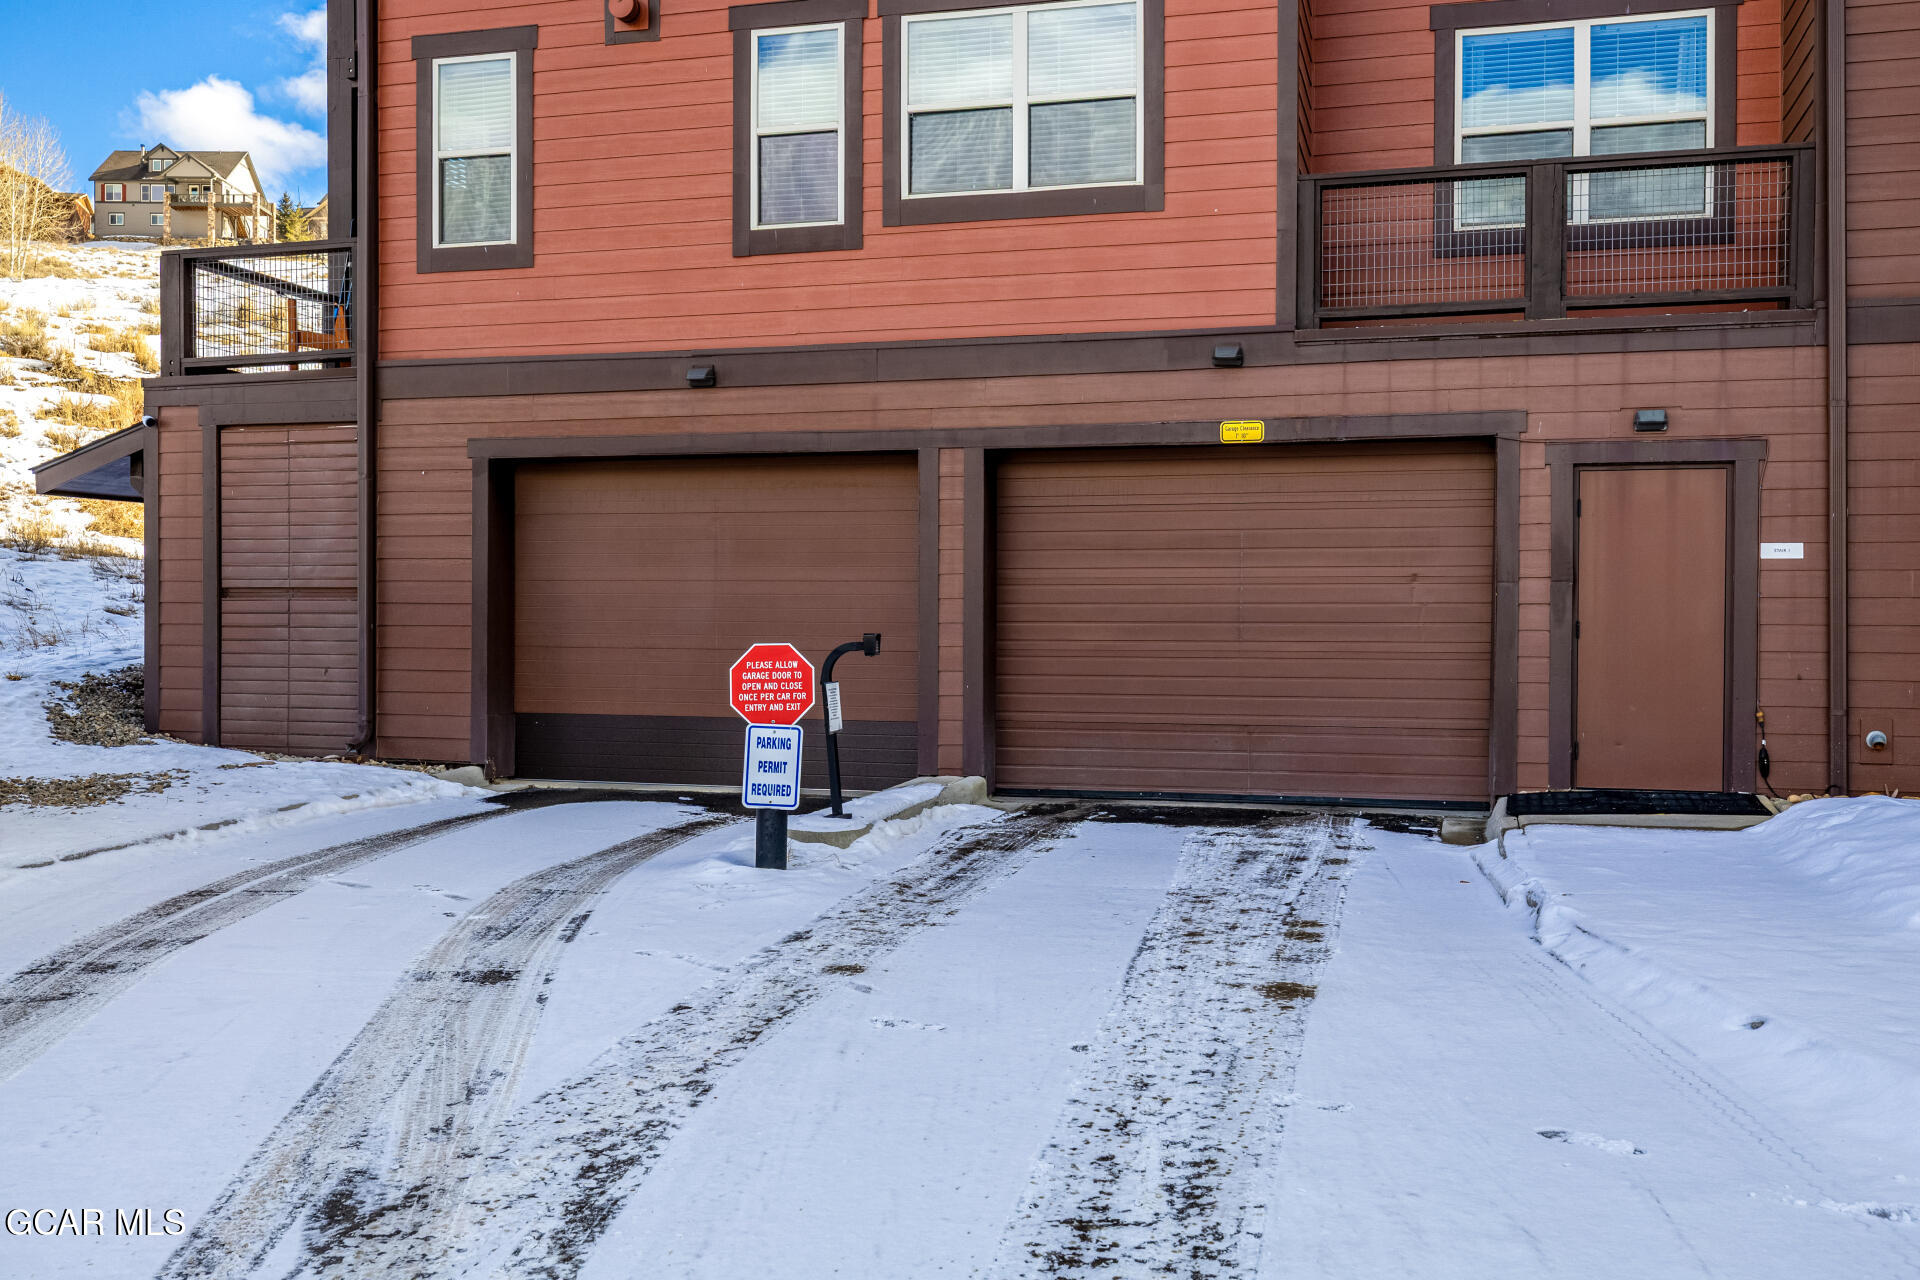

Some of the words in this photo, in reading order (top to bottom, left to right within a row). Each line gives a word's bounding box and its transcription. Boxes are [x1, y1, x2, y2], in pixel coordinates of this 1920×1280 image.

[746, 661, 773, 669] PLEASE
[775, 660, 798, 668] ALLOW
[742, 672, 770, 680] GARAGE
[772, 672, 792, 680] DOOR
[742, 682, 762, 690] OPEN
[764, 682, 778, 690] AND
[780, 682, 803, 690] CLOSE
[738, 693, 758, 701] ONCE
[744, 704, 767, 712] ENTRY
[769, 703, 784, 711] AND
[786, 702, 800, 710] EXIT
[756, 736, 792, 750] PARKING
[758, 760, 788, 774] PERMIT
[752, 783, 792, 796] REQUIRED
